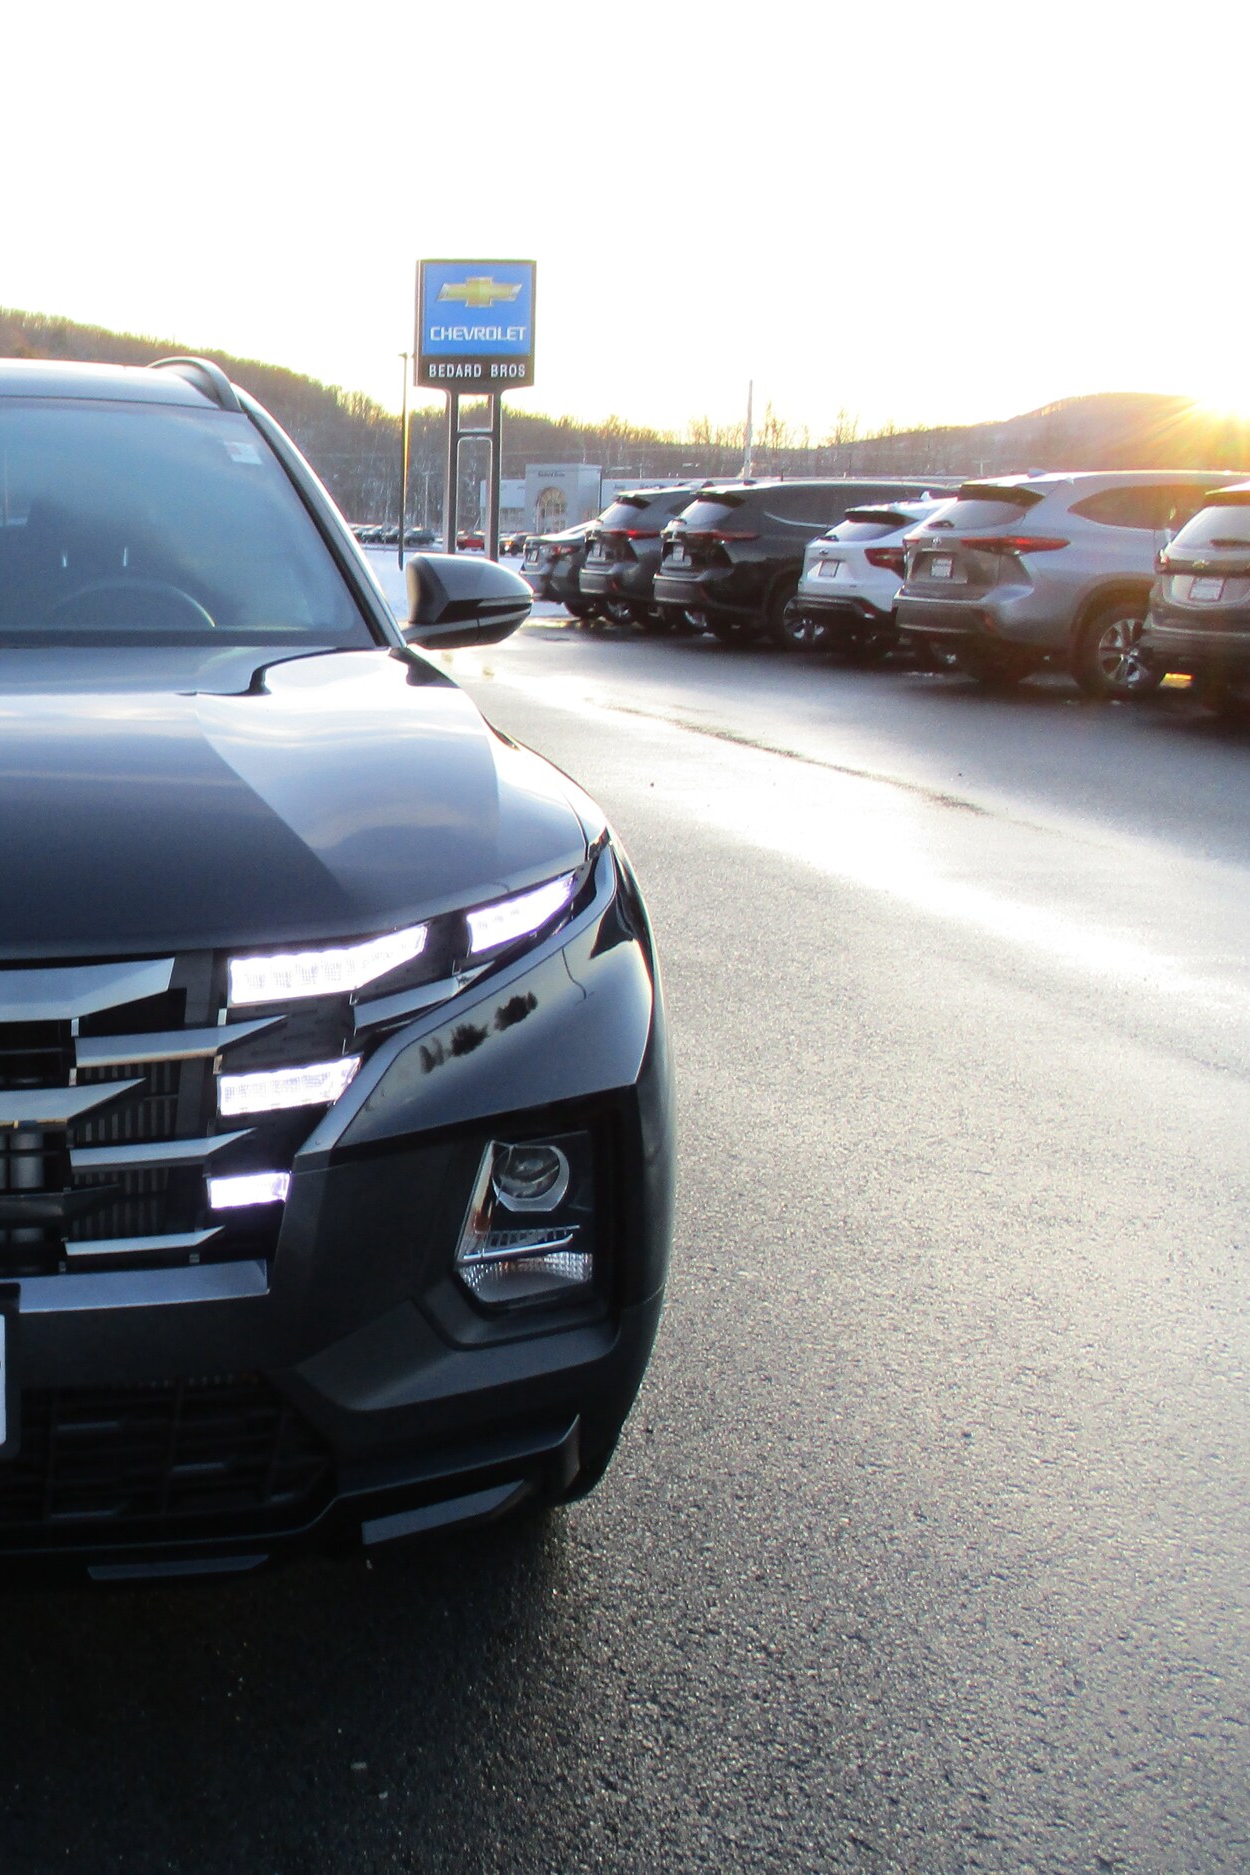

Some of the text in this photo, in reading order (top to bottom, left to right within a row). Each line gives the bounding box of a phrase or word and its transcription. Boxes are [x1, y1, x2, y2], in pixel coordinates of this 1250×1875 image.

[430, 326, 527, 341] CHEVROLET
[429, 364, 526, 378] BEDARD BROS
